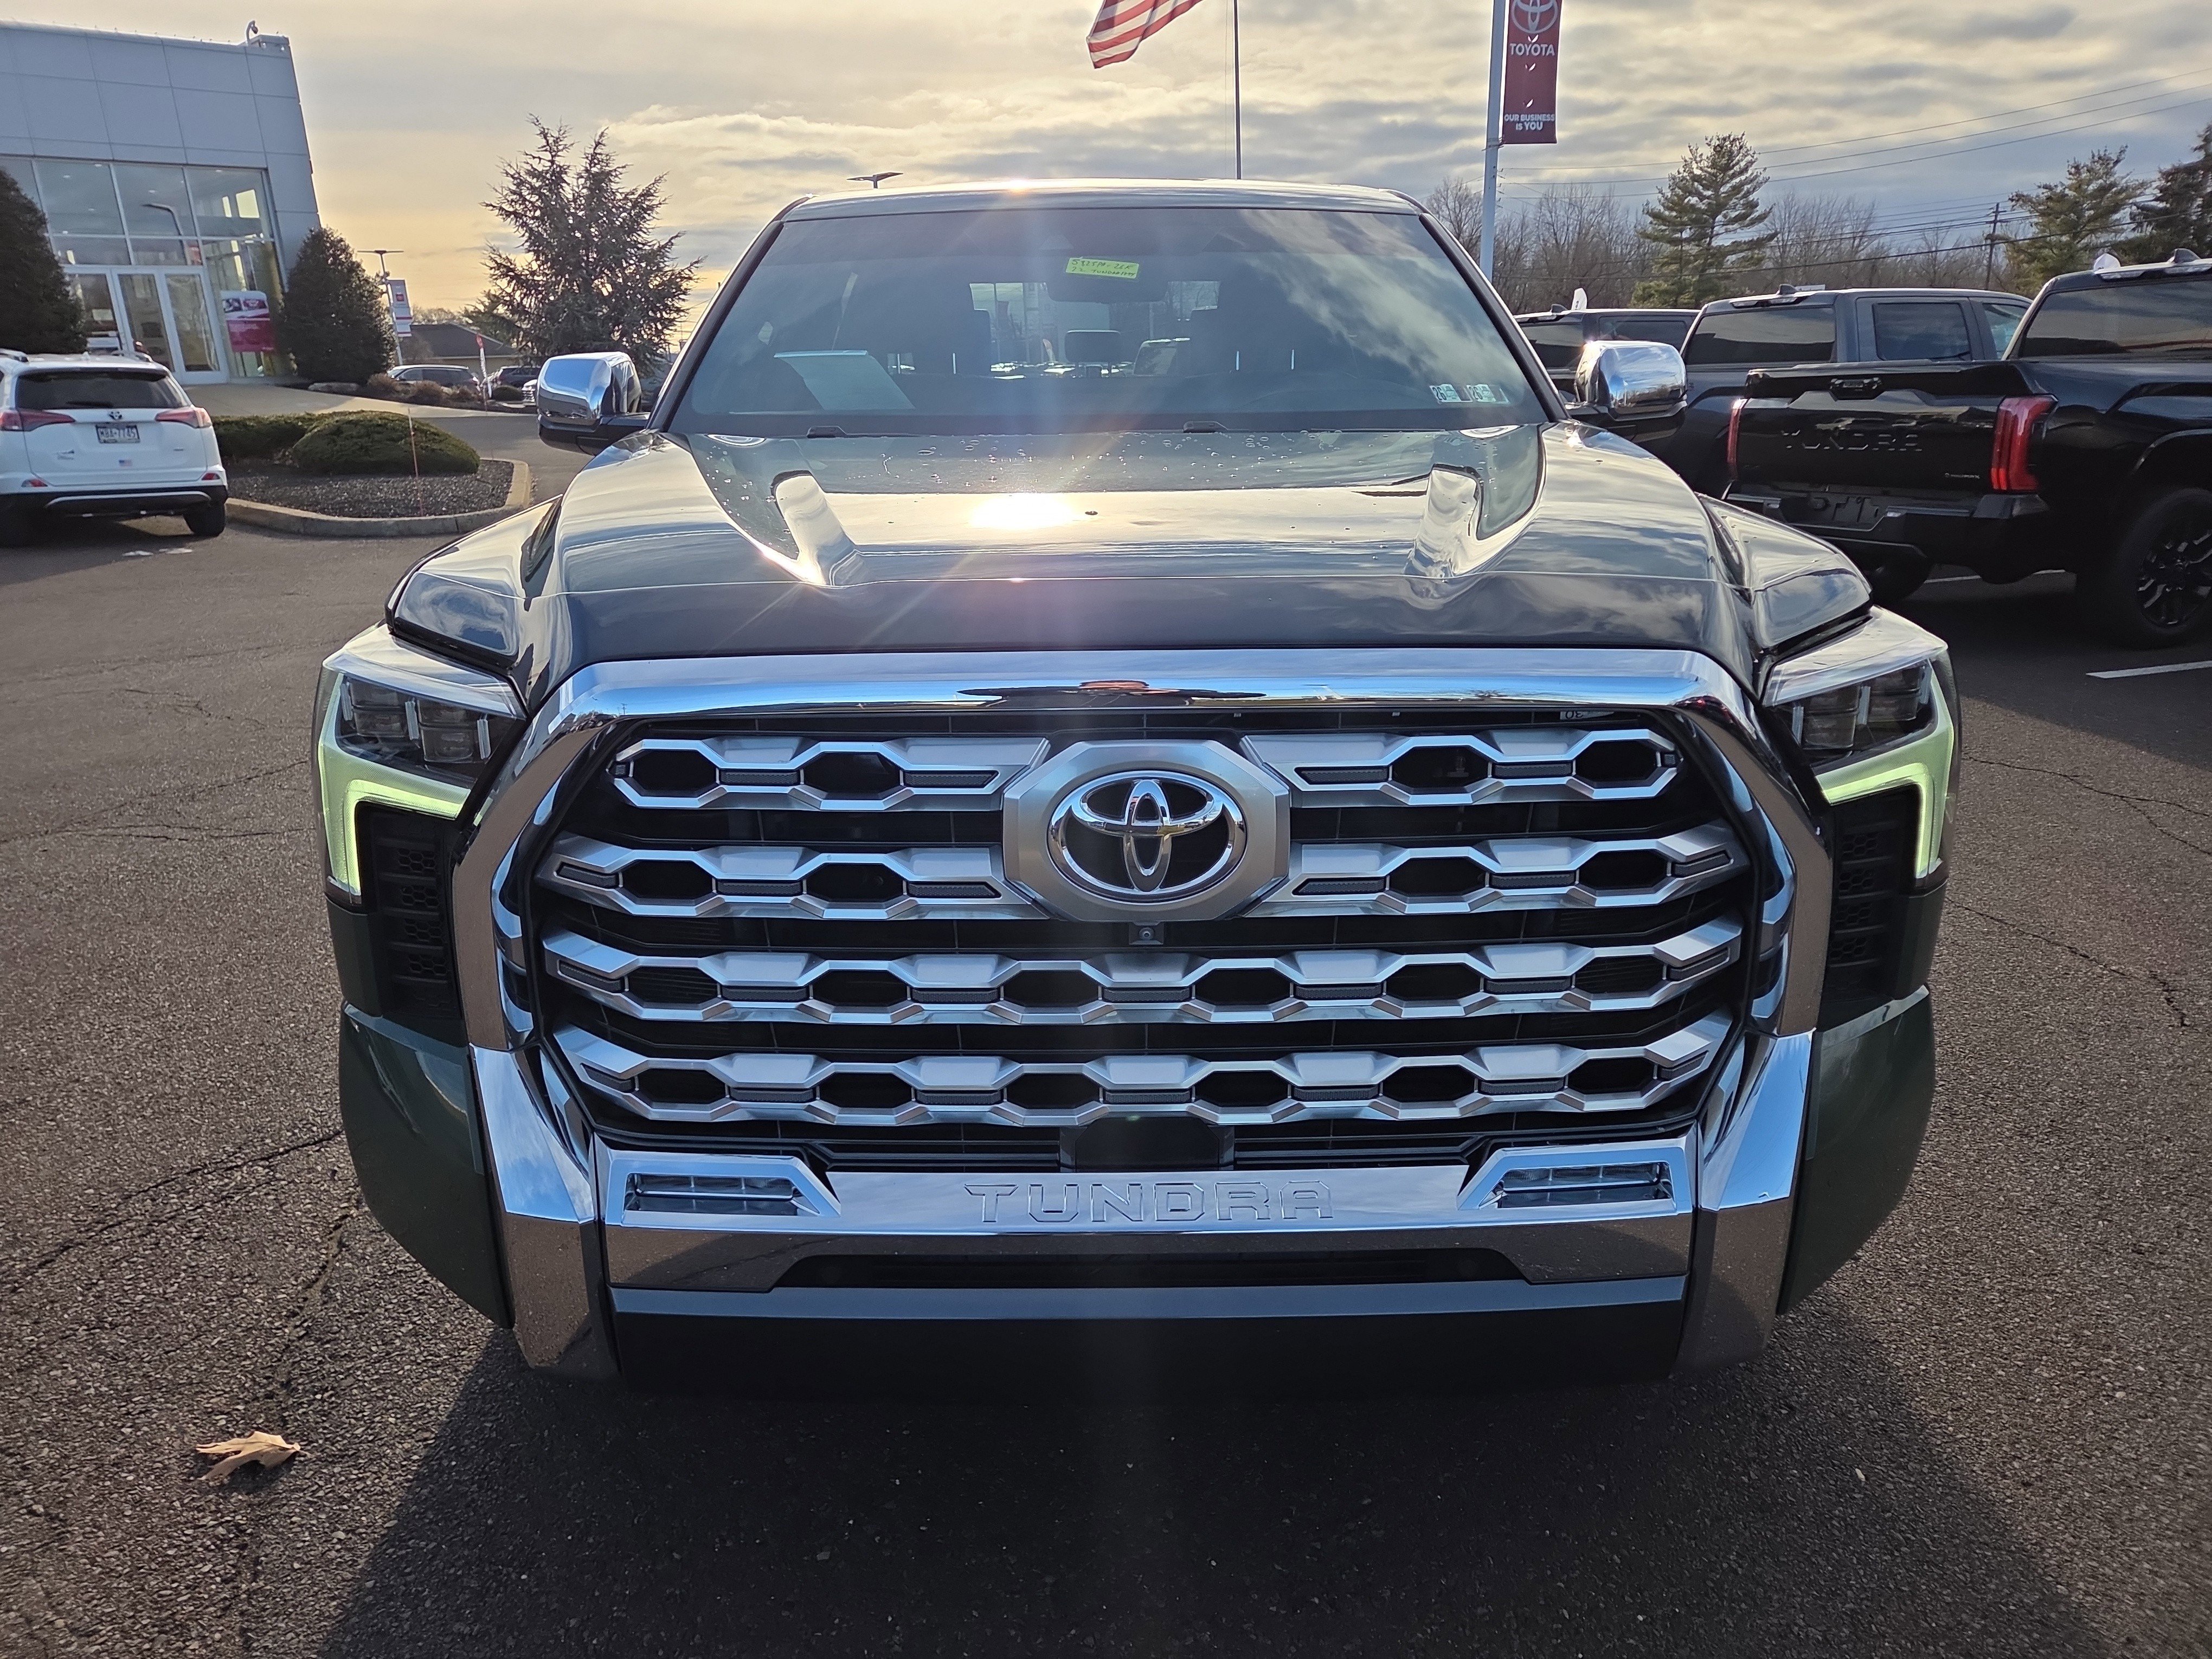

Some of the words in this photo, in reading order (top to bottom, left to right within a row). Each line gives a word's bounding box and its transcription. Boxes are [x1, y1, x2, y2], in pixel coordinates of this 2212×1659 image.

[1509, 43, 1555, 56] TOYOTA
[1504, 113, 1520, 122] OUR
[1520, 113, 1555, 122] BUSINESS
[1524, 121, 1543, 131] YOU
[964, 1181, 1333, 1223] TUNDRA
